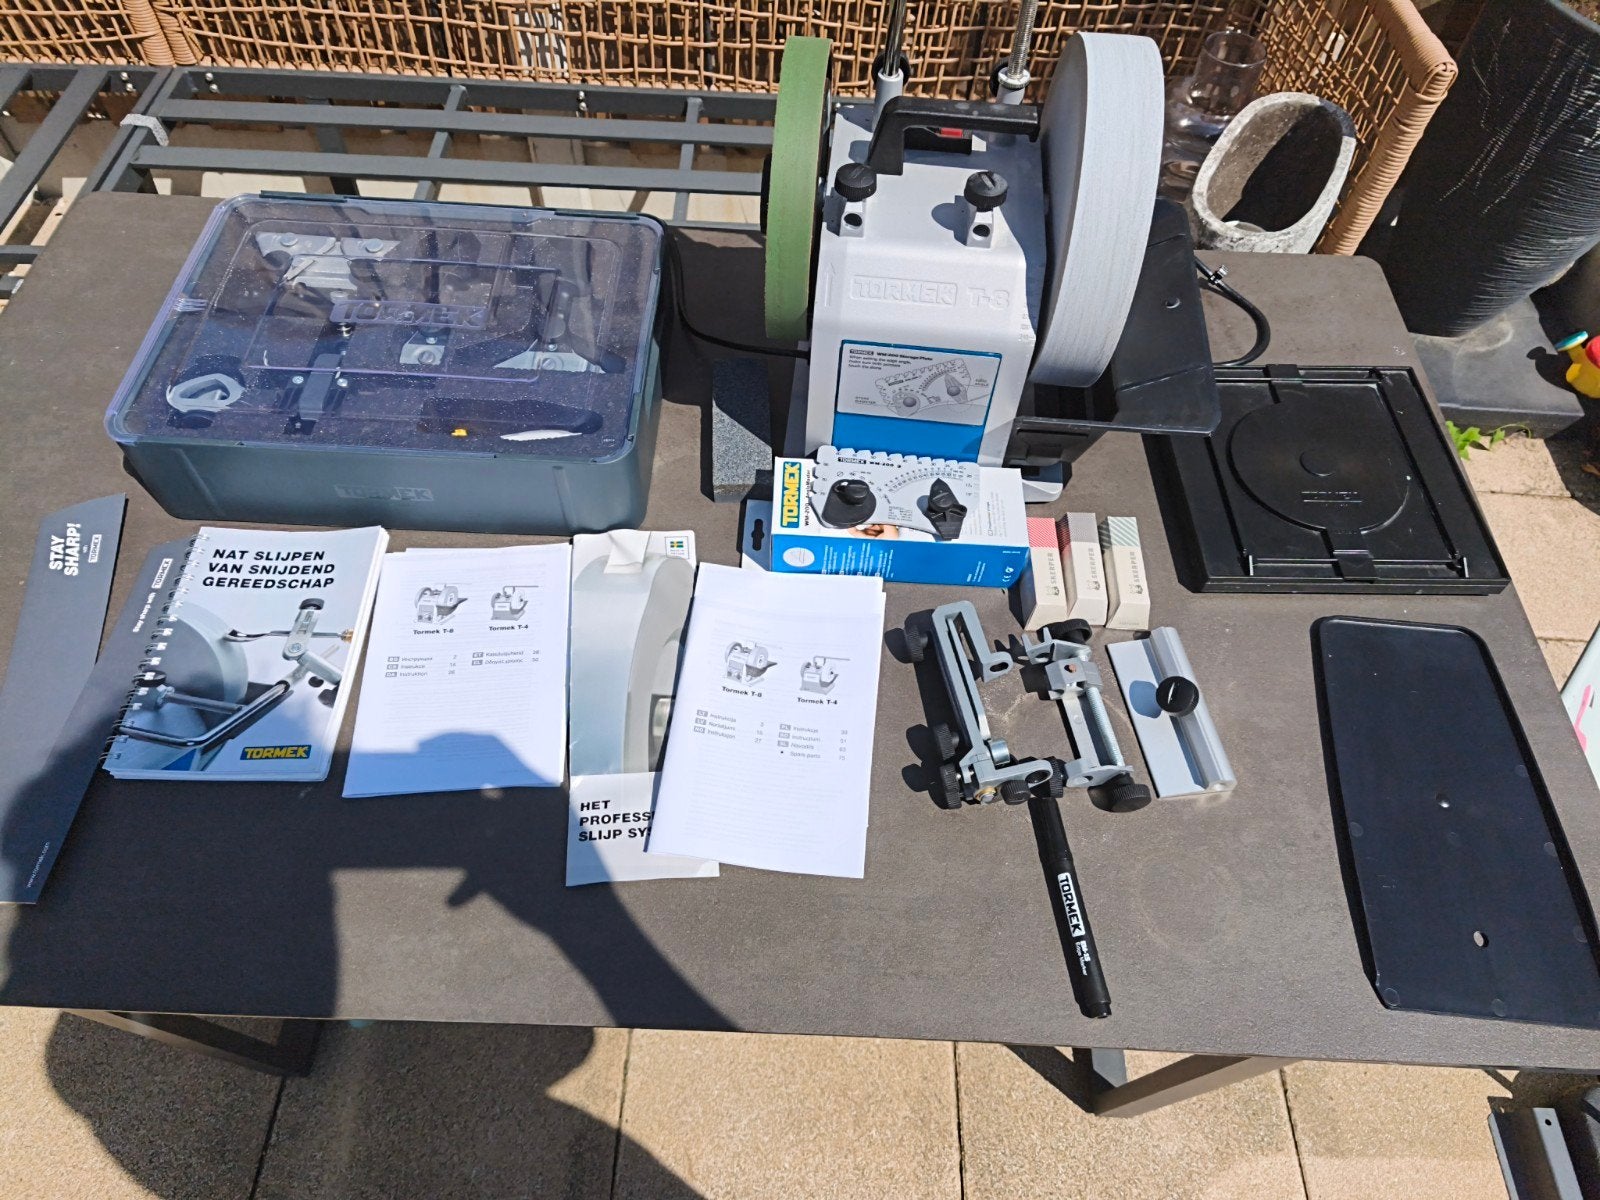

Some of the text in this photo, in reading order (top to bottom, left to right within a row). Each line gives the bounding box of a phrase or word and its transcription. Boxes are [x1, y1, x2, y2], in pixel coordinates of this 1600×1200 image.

[853, 280, 955, 305] TORMEK
[782, 463, 800, 527] TORMEK
[49, 535, 65, 570] STAY
[64, 523, 81, 576] SHARP!
[89, 535, 101, 562] TORMEK
[213, 549, 325, 561] NAT SLIJPEN
[152, 559, 172, 588] TORMEK
[208, 562, 335, 575] VAN SNIJDEND
[202, 576, 335, 589] GEREEDSCHAP
[722, 686, 748, 696] Tormek
[797, 697, 824, 705] Tormek
[244, 746, 309, 759] TORMEK
[580, 800, 611, 811] HET
[578, 829, 622, 842] SLIJP
[1059, 874, 1082, 934] TORMEK
